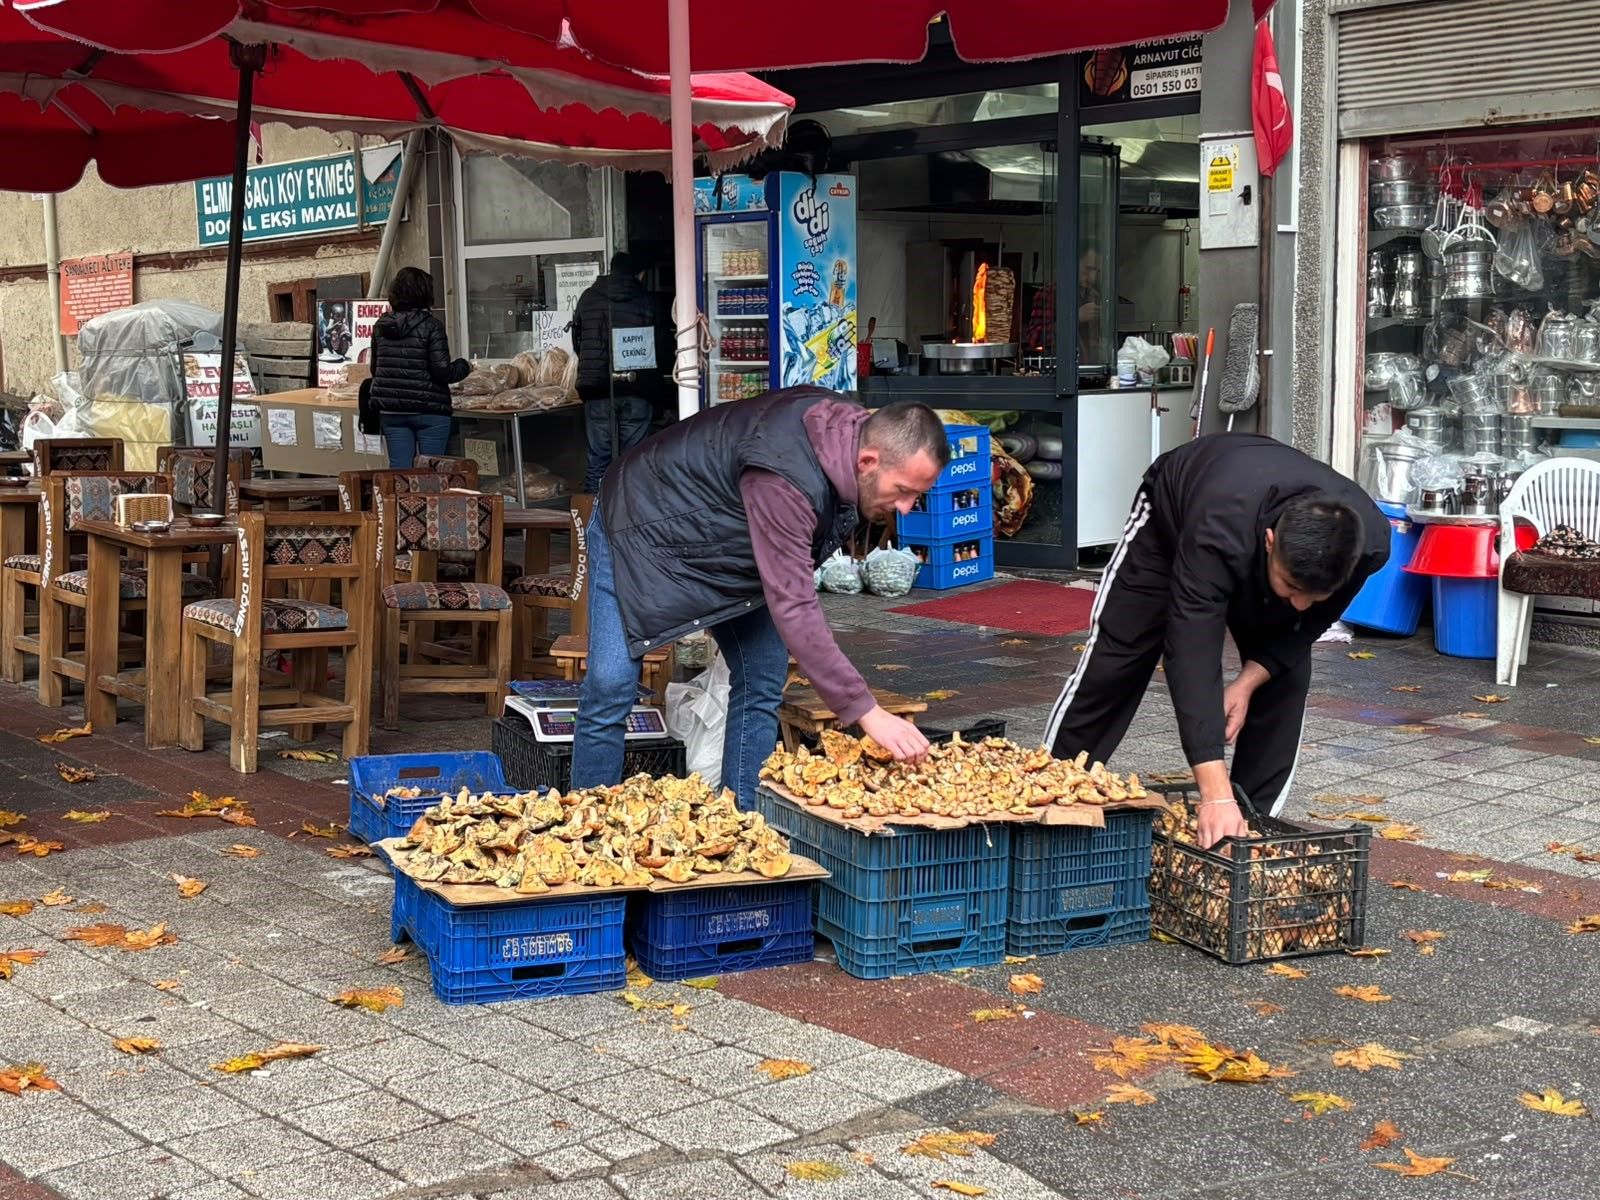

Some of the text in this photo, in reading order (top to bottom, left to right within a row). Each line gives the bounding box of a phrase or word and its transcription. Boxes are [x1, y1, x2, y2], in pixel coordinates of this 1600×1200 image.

[1133, 49, 1180, 65] ARNAVUT
[1145, 69, 1179, 81] SİPARRİŞ
[1133, 77, 1198, 96] 0501 550 03
[277, 167, 304, 205] KÖY
[355, 321, 374, 338] İSRA
[621, 349, 647, 359] ÇEKİNİZ
[951, 461, 977, 477] pepsi
[41, 491, 52, 534] ASRIN
[952, 512, 978, 528] pepsi
[569, 509, 587, 601] ASRIN DÖNER
[953, 563, 979, 579] pepsi
[234, 527, 250, 638] ASRIN DÖNER
